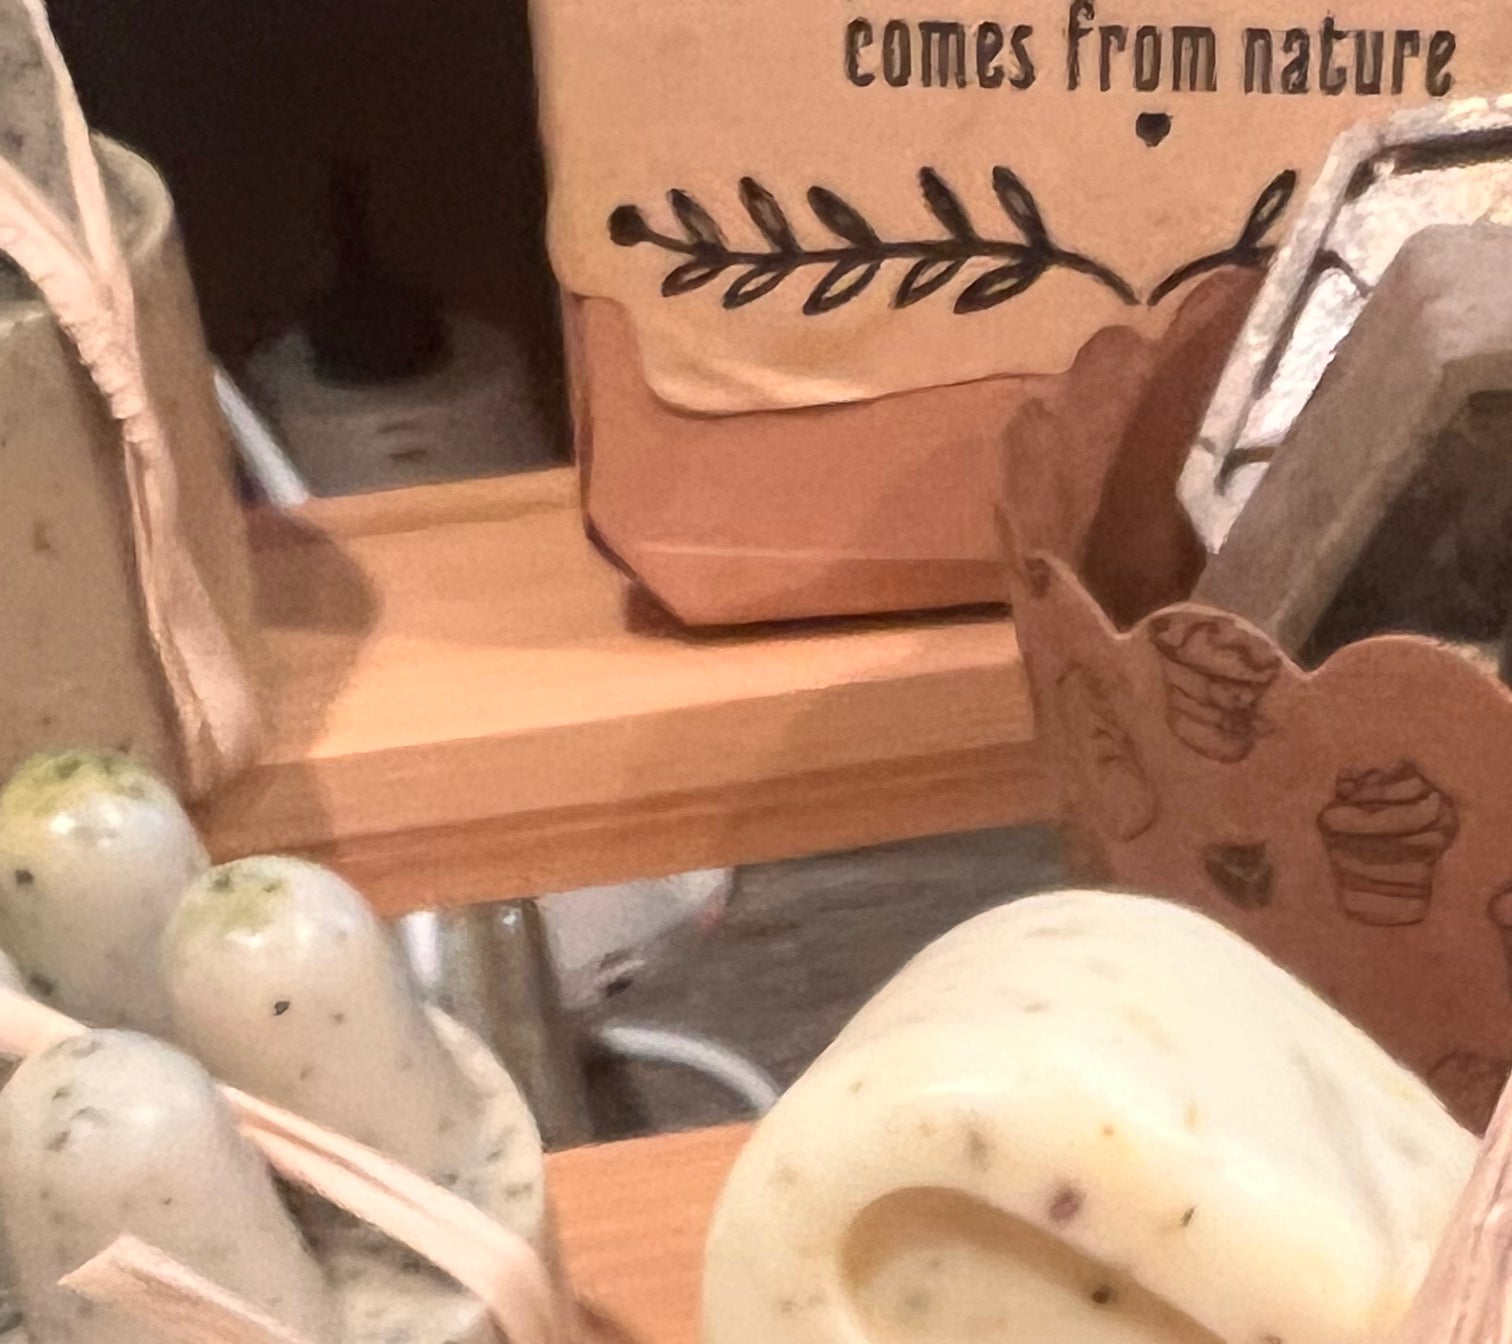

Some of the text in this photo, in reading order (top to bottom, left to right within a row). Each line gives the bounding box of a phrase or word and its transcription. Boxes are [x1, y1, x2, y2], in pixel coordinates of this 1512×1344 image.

[844, 0, 1457, 96] comes from nature
